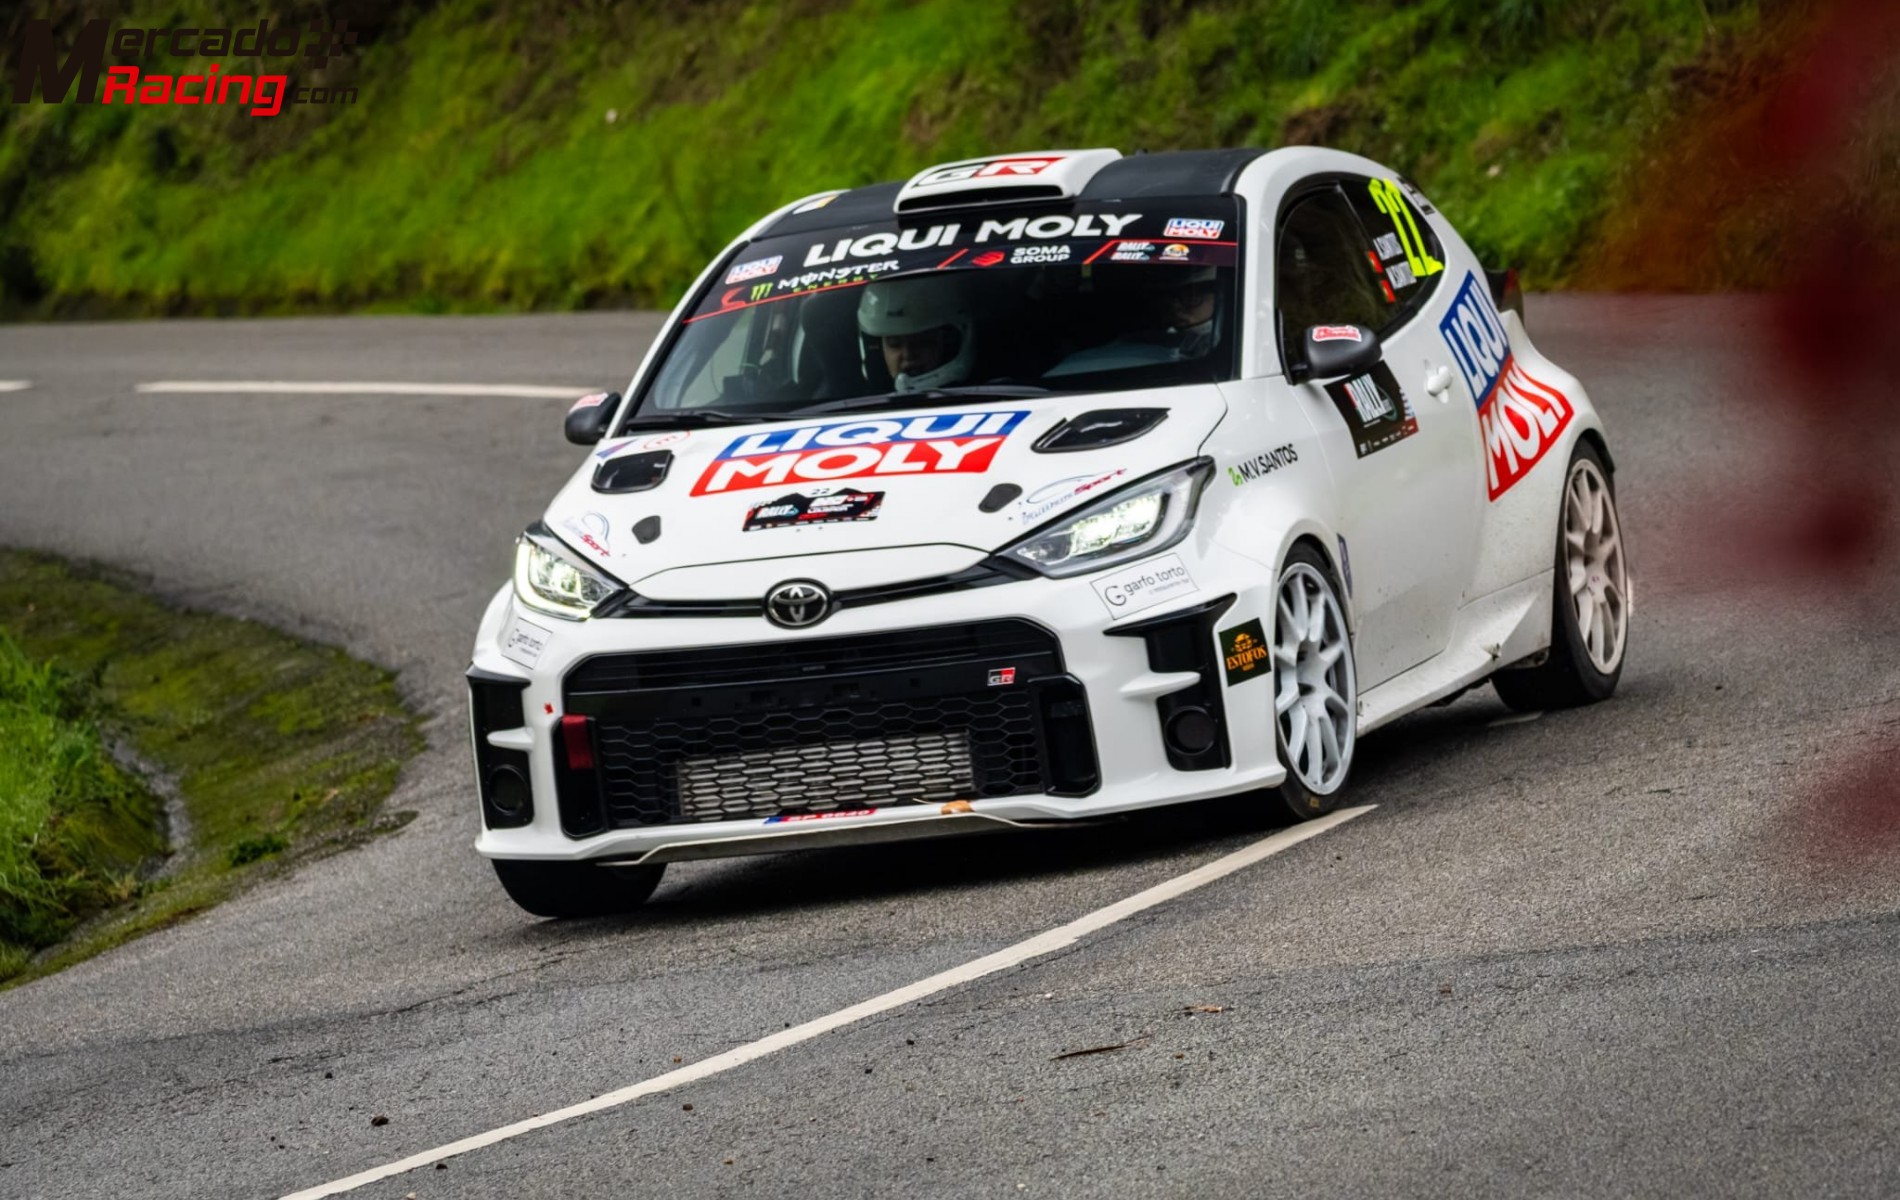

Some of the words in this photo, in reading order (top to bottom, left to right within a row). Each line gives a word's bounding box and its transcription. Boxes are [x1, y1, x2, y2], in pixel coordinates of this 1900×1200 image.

[915, 158, 1053, 188] GR
[1166, 228, 1220, 239] MOLY
[1170, 218, 1224, 230] LIQUI
[803, 223, 961, 267] LIQUI
[974, 214, 1143, 243] MOLY
[1013, 245, 1071, 256] SOMA
[1010, 253, 1071, 264] GROUP
[1444, 279, 1508, 400] LIQUI
[731, 412, 1016, 457] LIQUI
[1481, 361, 1567, 491] MOLY
[704, 436, 1003, 492] MOLY
[581, 533, 611, 557] Sport
[1123, 575, 1156, 596] garfo
[1155, 566, 1185, 582] torto
[989, 673, 1014, 686] GR
